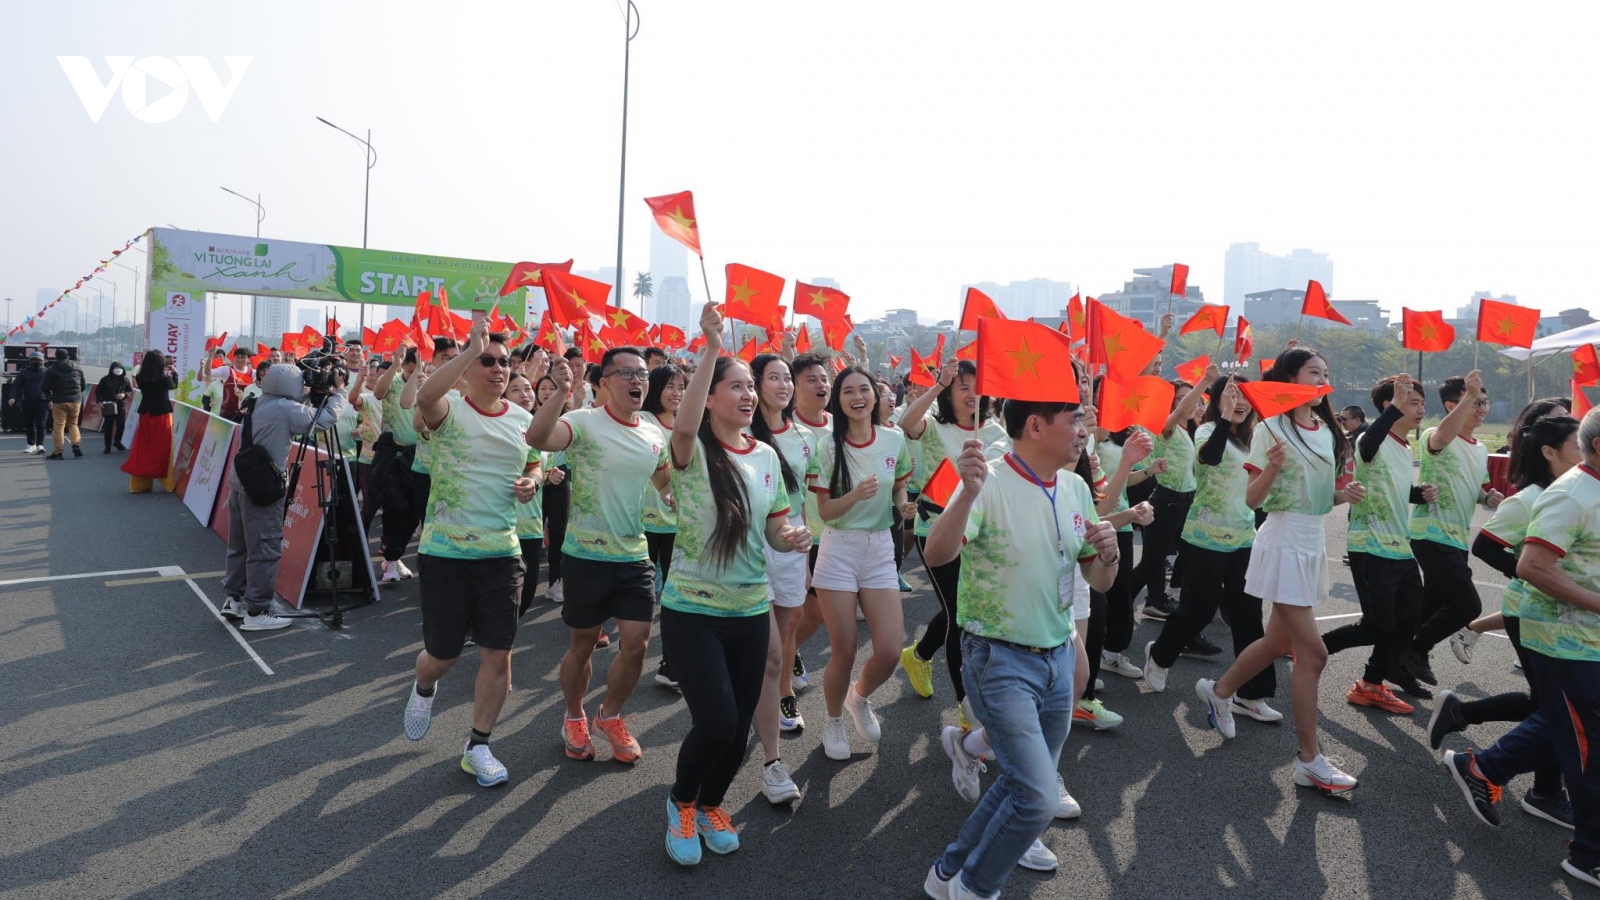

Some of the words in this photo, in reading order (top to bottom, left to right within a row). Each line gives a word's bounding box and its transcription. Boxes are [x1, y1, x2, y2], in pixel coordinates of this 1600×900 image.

[195, 252, 206, 263] VÌ
[254, 258, 272, 268] LAI
[215, 246, 251, 255] AGRIBANK
[360, 270, 445, 299] START
[167, 323, 181, 353] CHẠY
